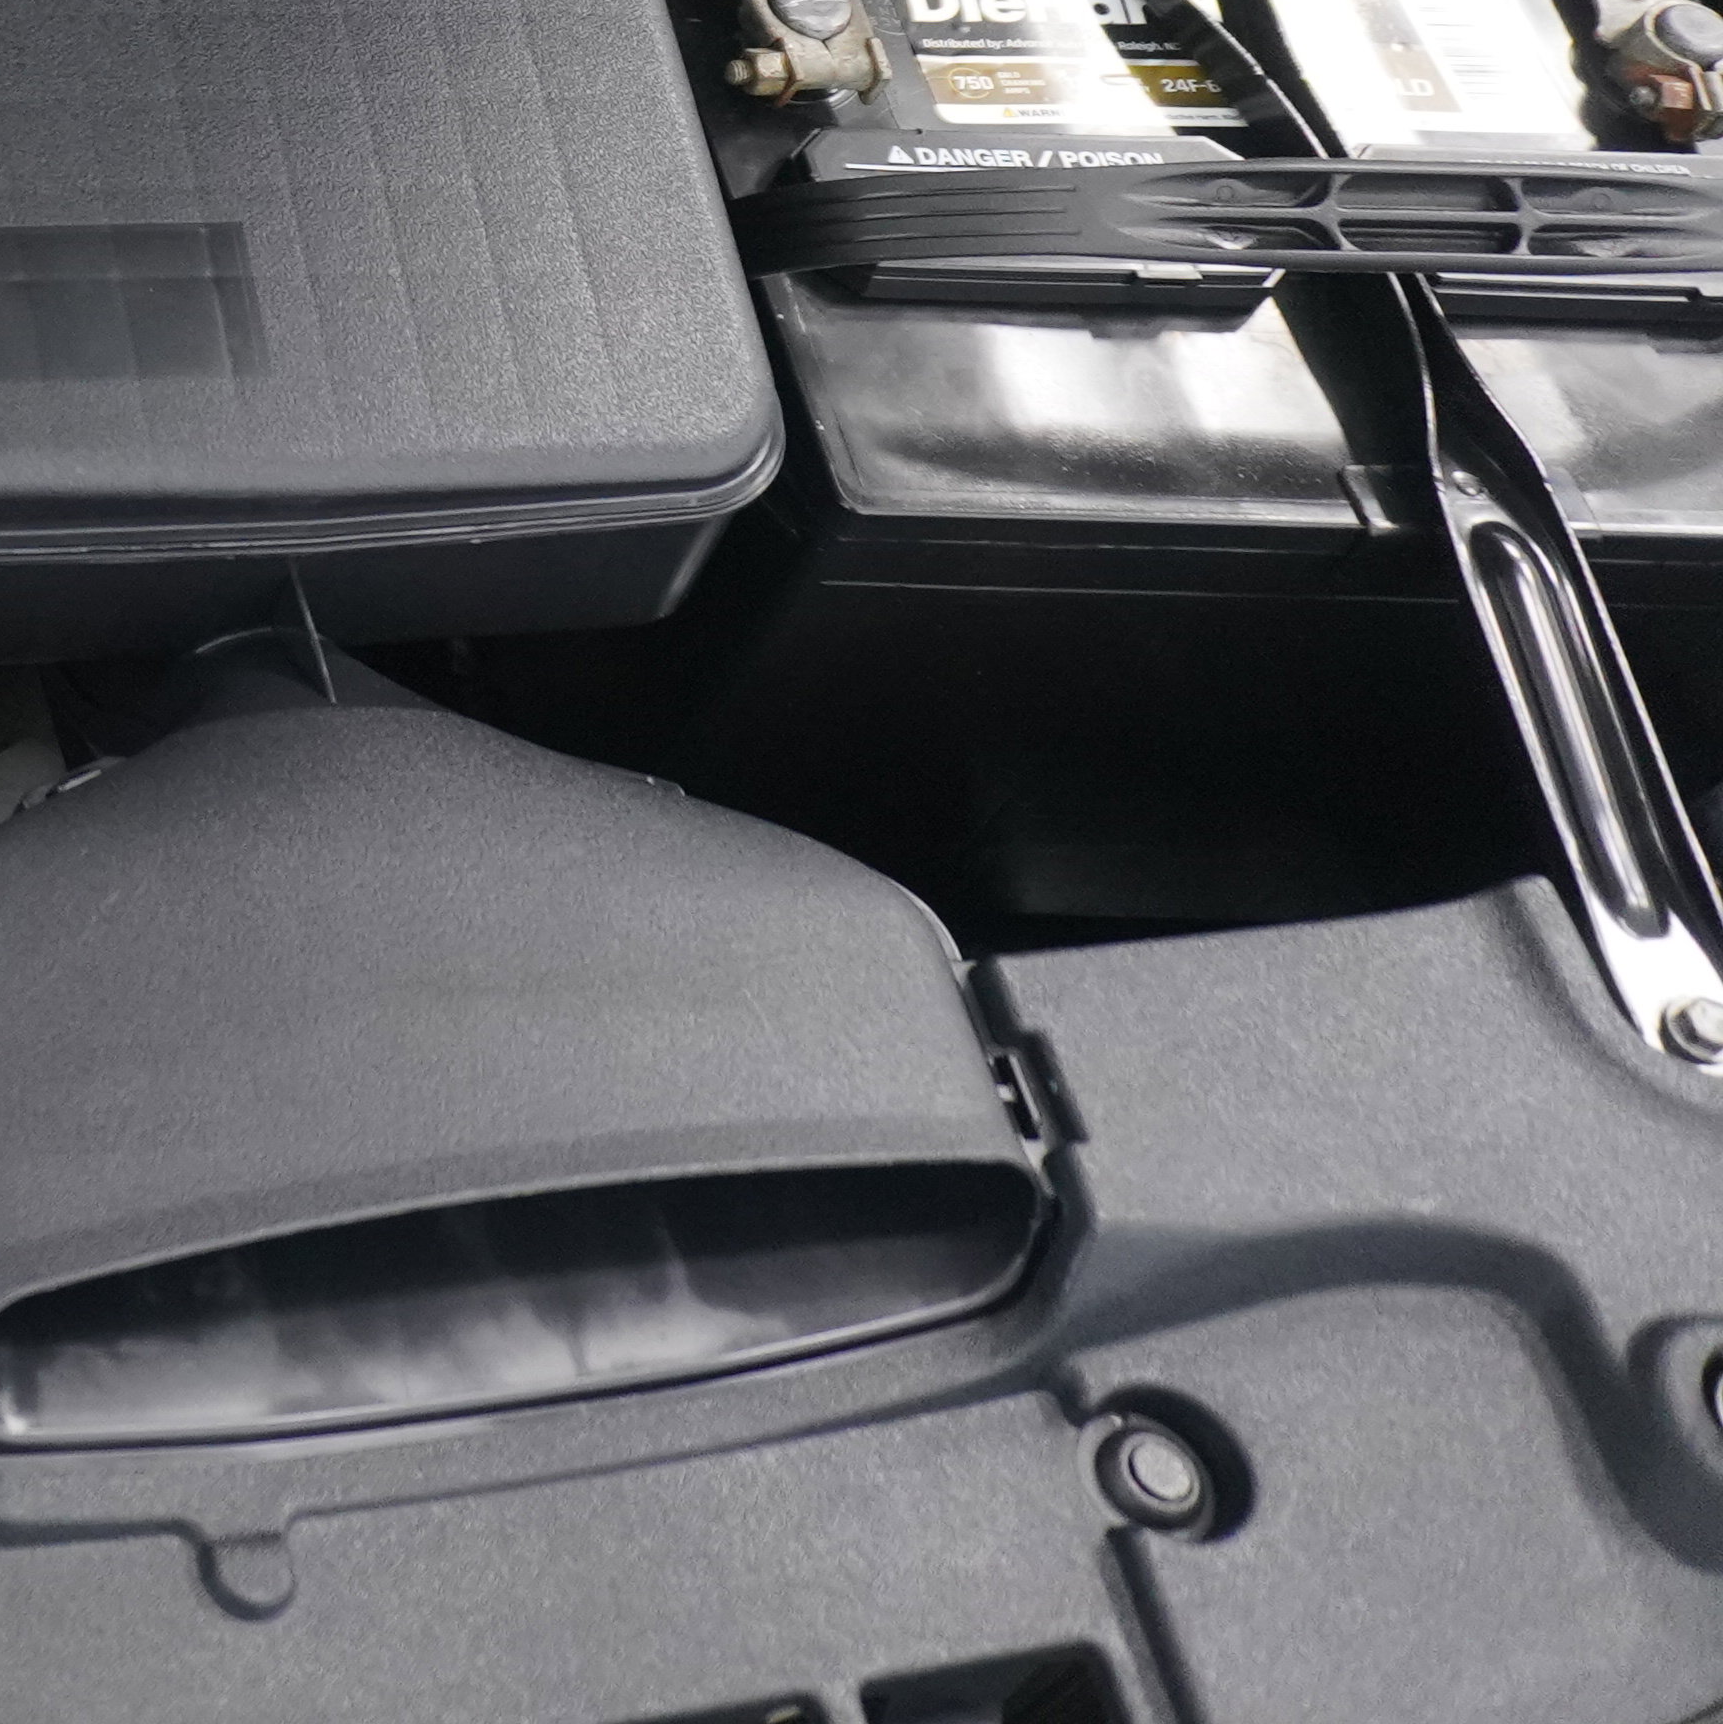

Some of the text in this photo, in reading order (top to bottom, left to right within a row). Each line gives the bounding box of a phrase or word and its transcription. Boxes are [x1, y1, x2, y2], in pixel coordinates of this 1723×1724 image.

[922, 38, 986, 50] Distributed
[953, 75, 995, 92] 750
[916, 147, 1032, 168] DANGER
[1059, 150, 1165, 169] POISON
